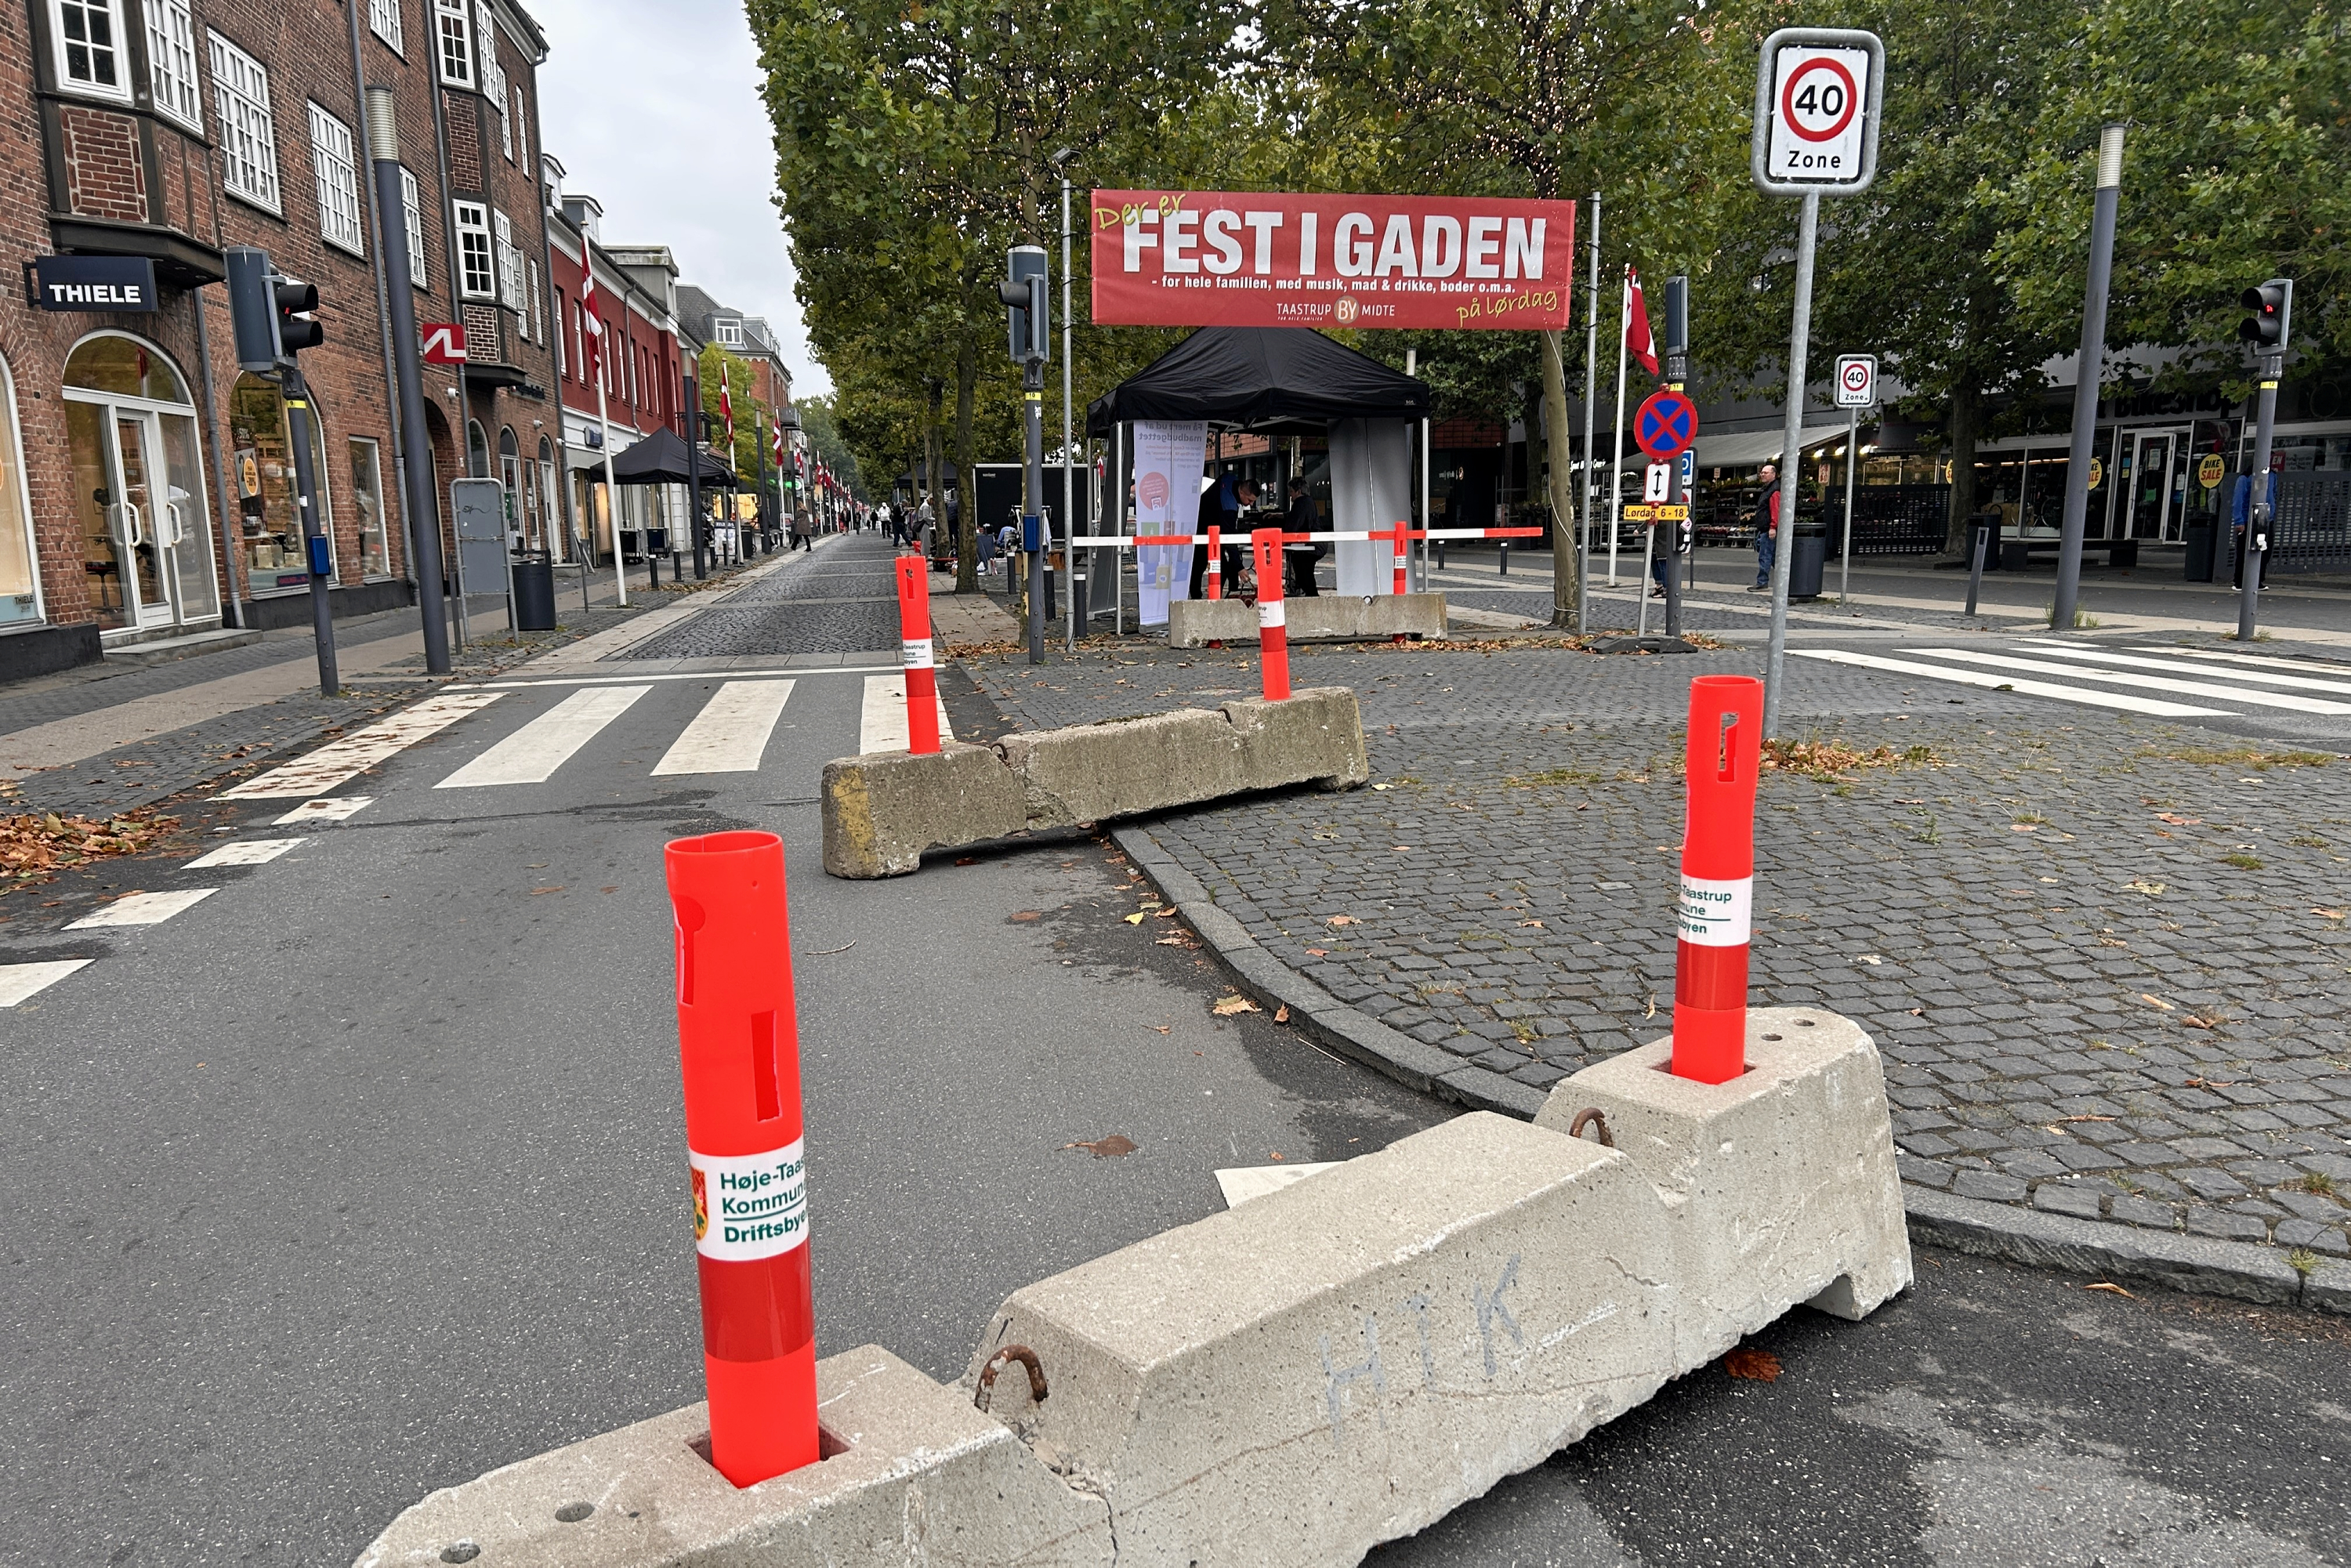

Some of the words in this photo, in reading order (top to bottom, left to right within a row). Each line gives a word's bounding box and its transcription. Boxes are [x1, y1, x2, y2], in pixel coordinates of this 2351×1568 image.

[1795, 85, 1843, 116] 40
[1788, 150, 1841, 168] Zone
[1094, 201, 1149, 230] Der
[1158, 193, 1186, 218] er
[1123, 208, 1284, 275] FEST
[1299, 212, 1317, 276] I
[1333, 212, 1547, 280] GADEN
[49, 284, 142, 303] THIELE
[1161, 275, 1181, 288] for
[1185, 276, 1212, 288] hele
[1215, 276, 1273, 292] familien,
[1276, 277, 1302, 290] med
[1306, 277, 1347, 292] musik,
[1352, 278, 1378, 291] mad
[1382, 279, 1390, 292] &
[1394, 280, 1436, 294] drikke,
[1440, 280, 1475, 292] boder
[1479, 282, 1516, 293] o.m.a.
[1276, 302, 1331, 315] TAASTRUP
[1337, 299, 1357, 320] BY
[1361, 305, 1396, 317] MIDTE
[1455, 296, 1482, 328] på
[1486, 288, 1559, 320] lørdag
[1847, 371, 1864, 382] 40
[2204, 458, 2221, 469] BIKE
[2201, 469, 2222, 480] SALE
[1625, 508, 1656, 517] Lørdag
[1661, 508, 1666, 517] 6
[1674, 508, 1684, 517] 18
[14, 595, 34, 605] THIELE
